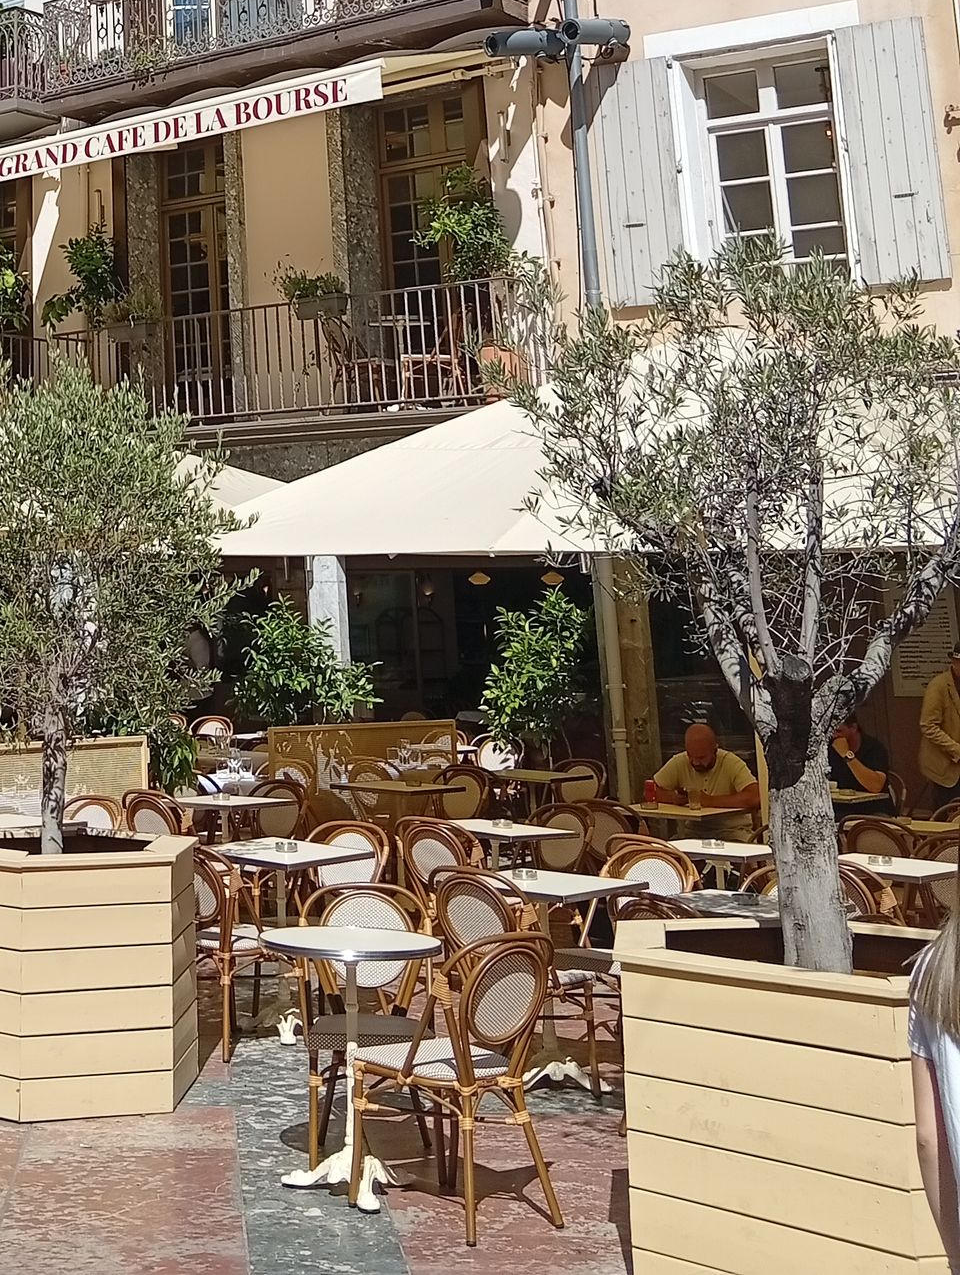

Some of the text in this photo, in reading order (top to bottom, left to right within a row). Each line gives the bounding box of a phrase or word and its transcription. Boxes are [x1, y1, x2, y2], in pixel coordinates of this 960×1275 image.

[84, 125, 146, 159] CAFE
[153, 115, 188, 144] DE
[195, 107, 228, 135] LA
[234, 78, 348, 127] BOURSE
